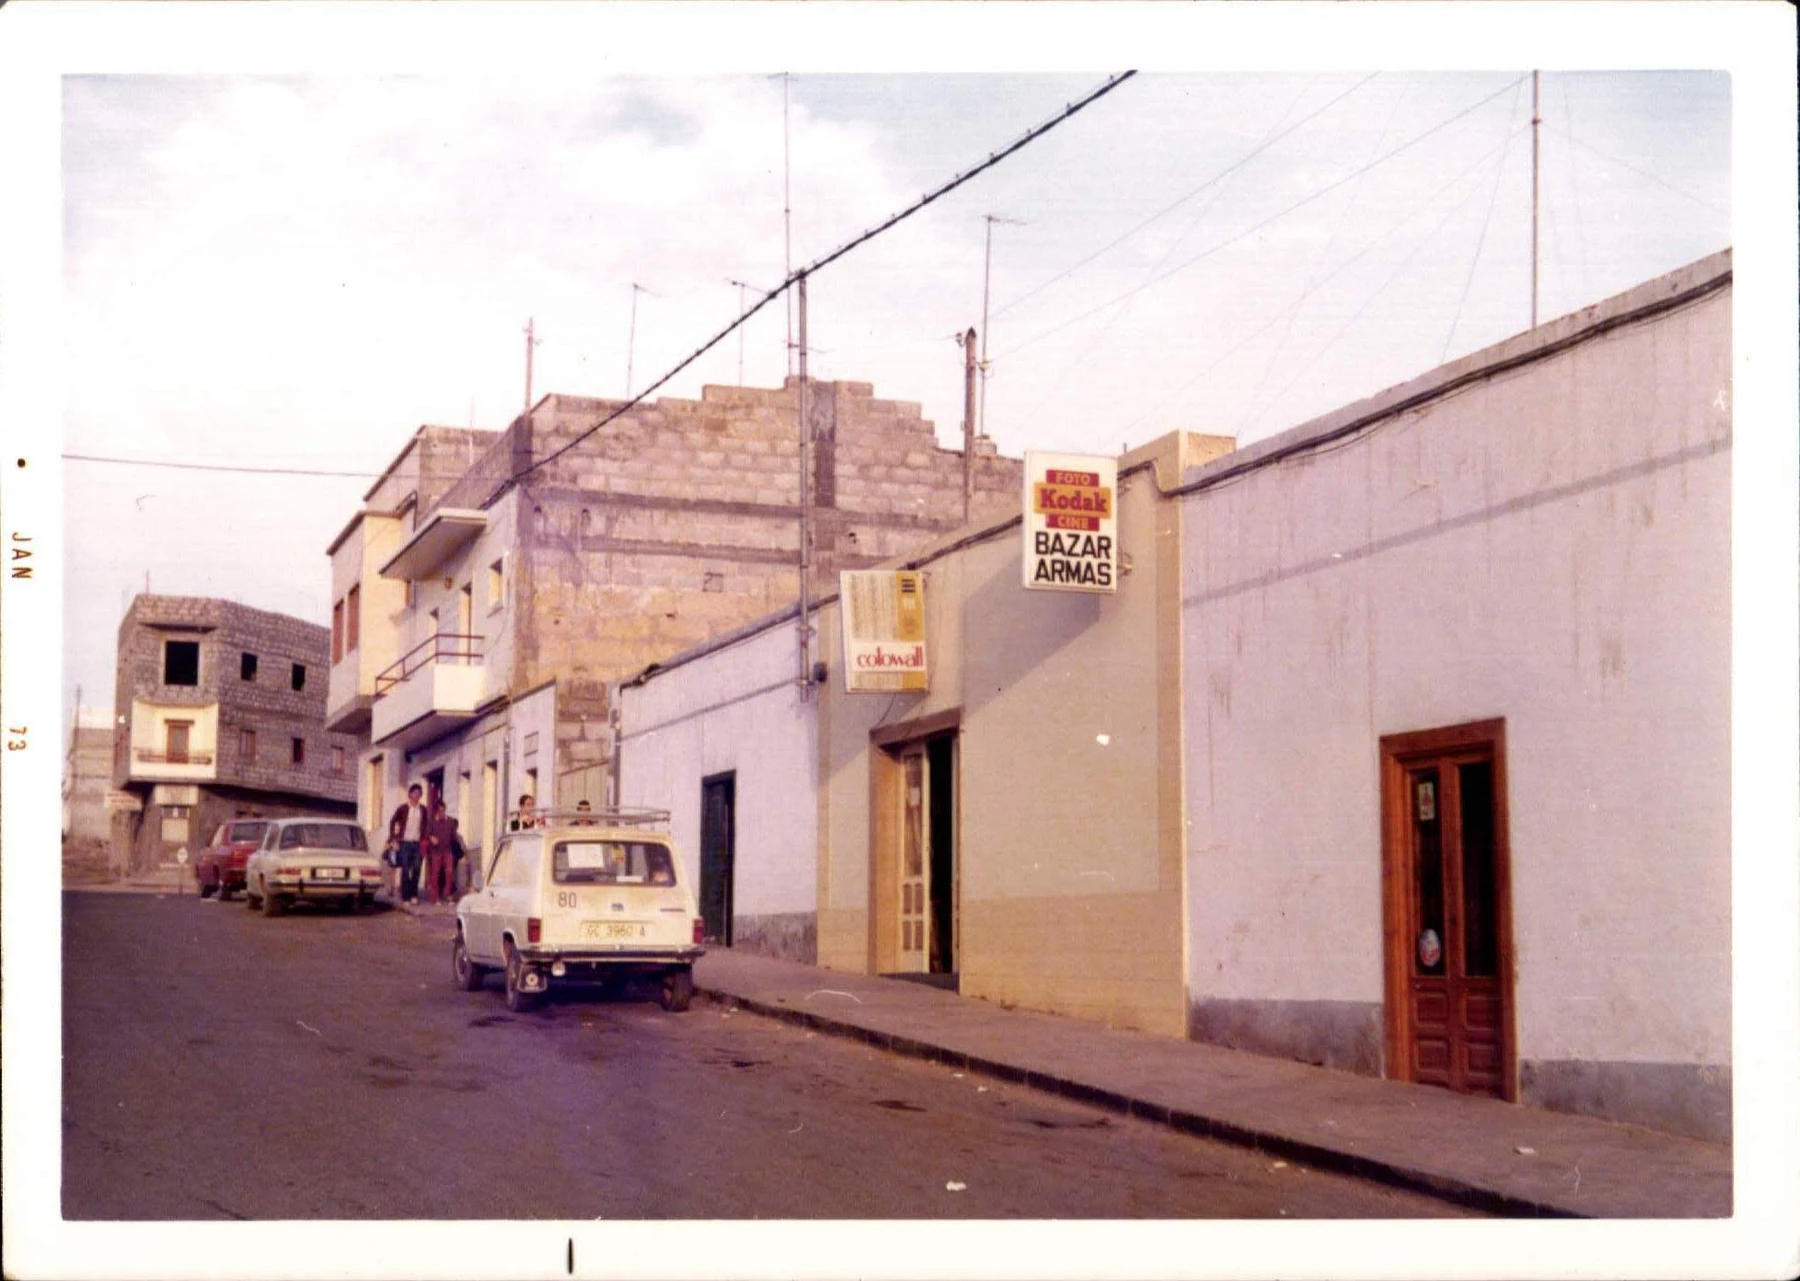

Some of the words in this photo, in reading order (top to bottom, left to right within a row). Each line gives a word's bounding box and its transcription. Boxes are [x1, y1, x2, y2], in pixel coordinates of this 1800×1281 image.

[1055, 474, 1091, 486] FOTO
[1040, 488, 1107, 513] Kodak
[1057, 516, 1089, 530] CINE
[1035, 531, 1112, 559] BAZAR
[1034, 558, 1112, 586] ARMAS
[557, 891, 577, 908] 80
